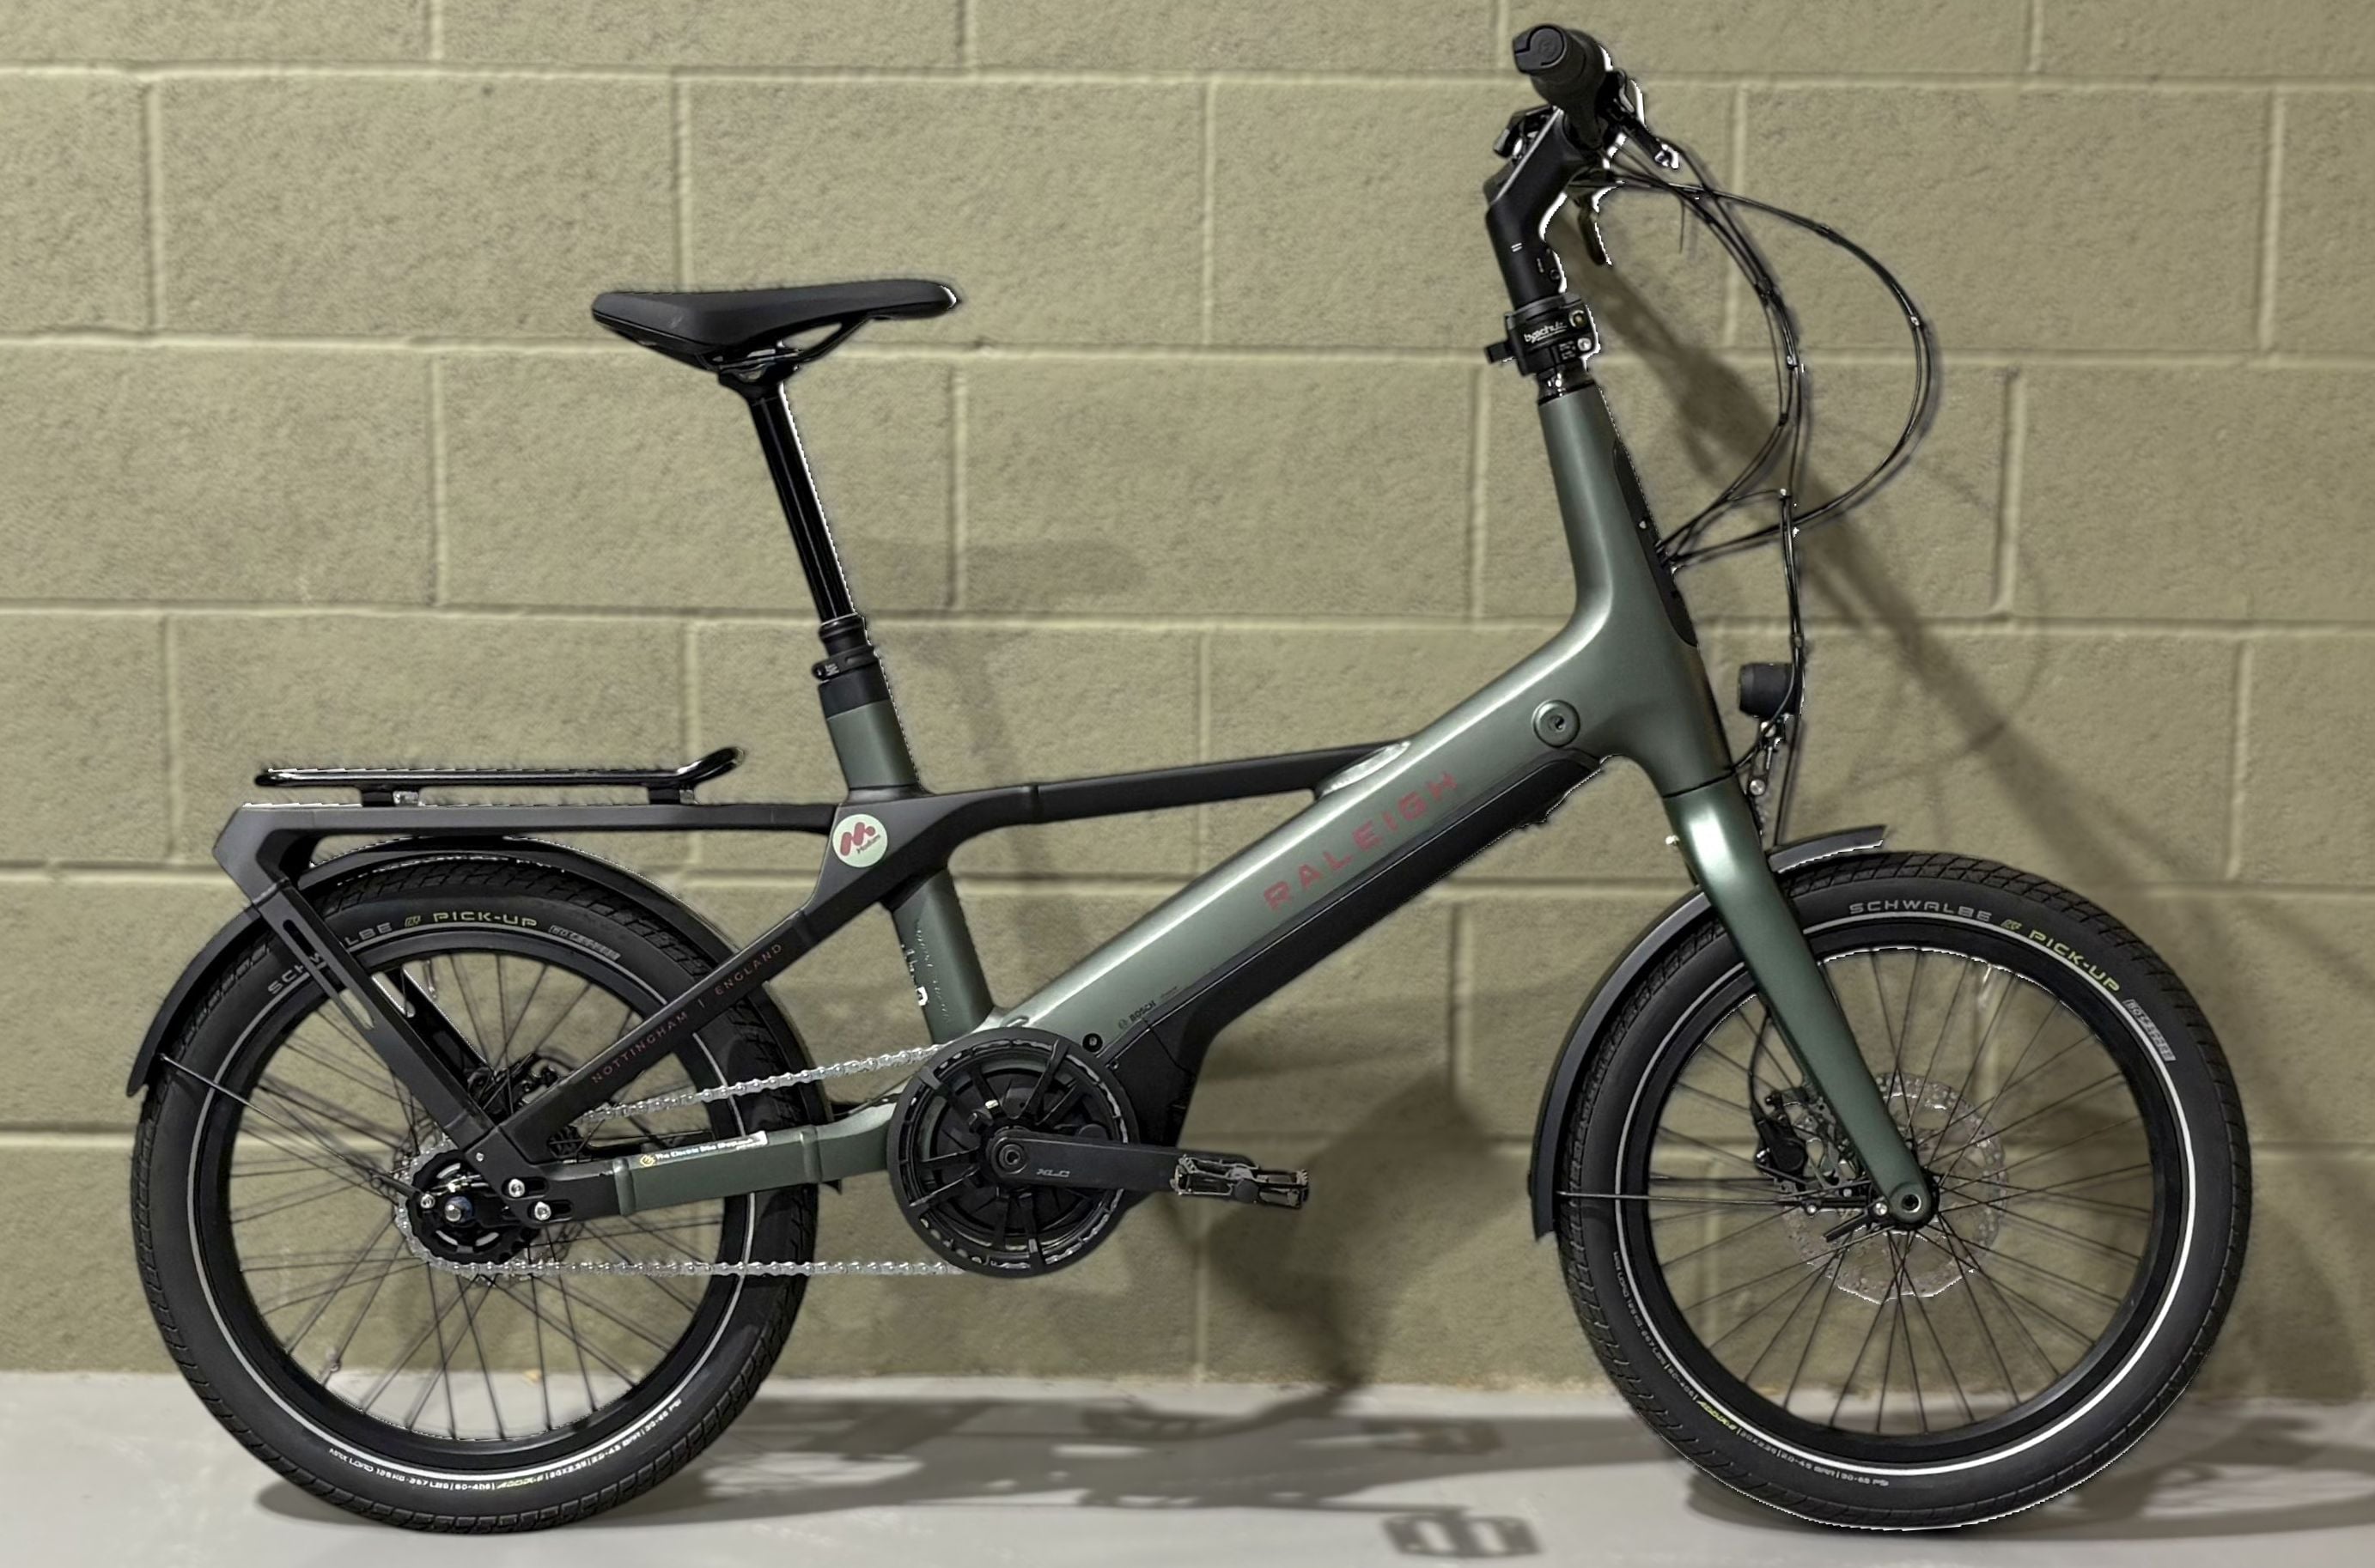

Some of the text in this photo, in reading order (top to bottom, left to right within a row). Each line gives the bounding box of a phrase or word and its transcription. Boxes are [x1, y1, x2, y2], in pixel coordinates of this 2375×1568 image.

[1263, 770, 1458, 913] RALEIGH
[432, 910, 538, 927] PICK-UP
[1848, 899, 2121, 994] SCHWALBE PICK-UP
[591, 1010, 687, 1085] NOTTINGHAM
[714, 943, 783, 995] ENGLAND
[1128, 1000, 1158, 1024] BOSCH
